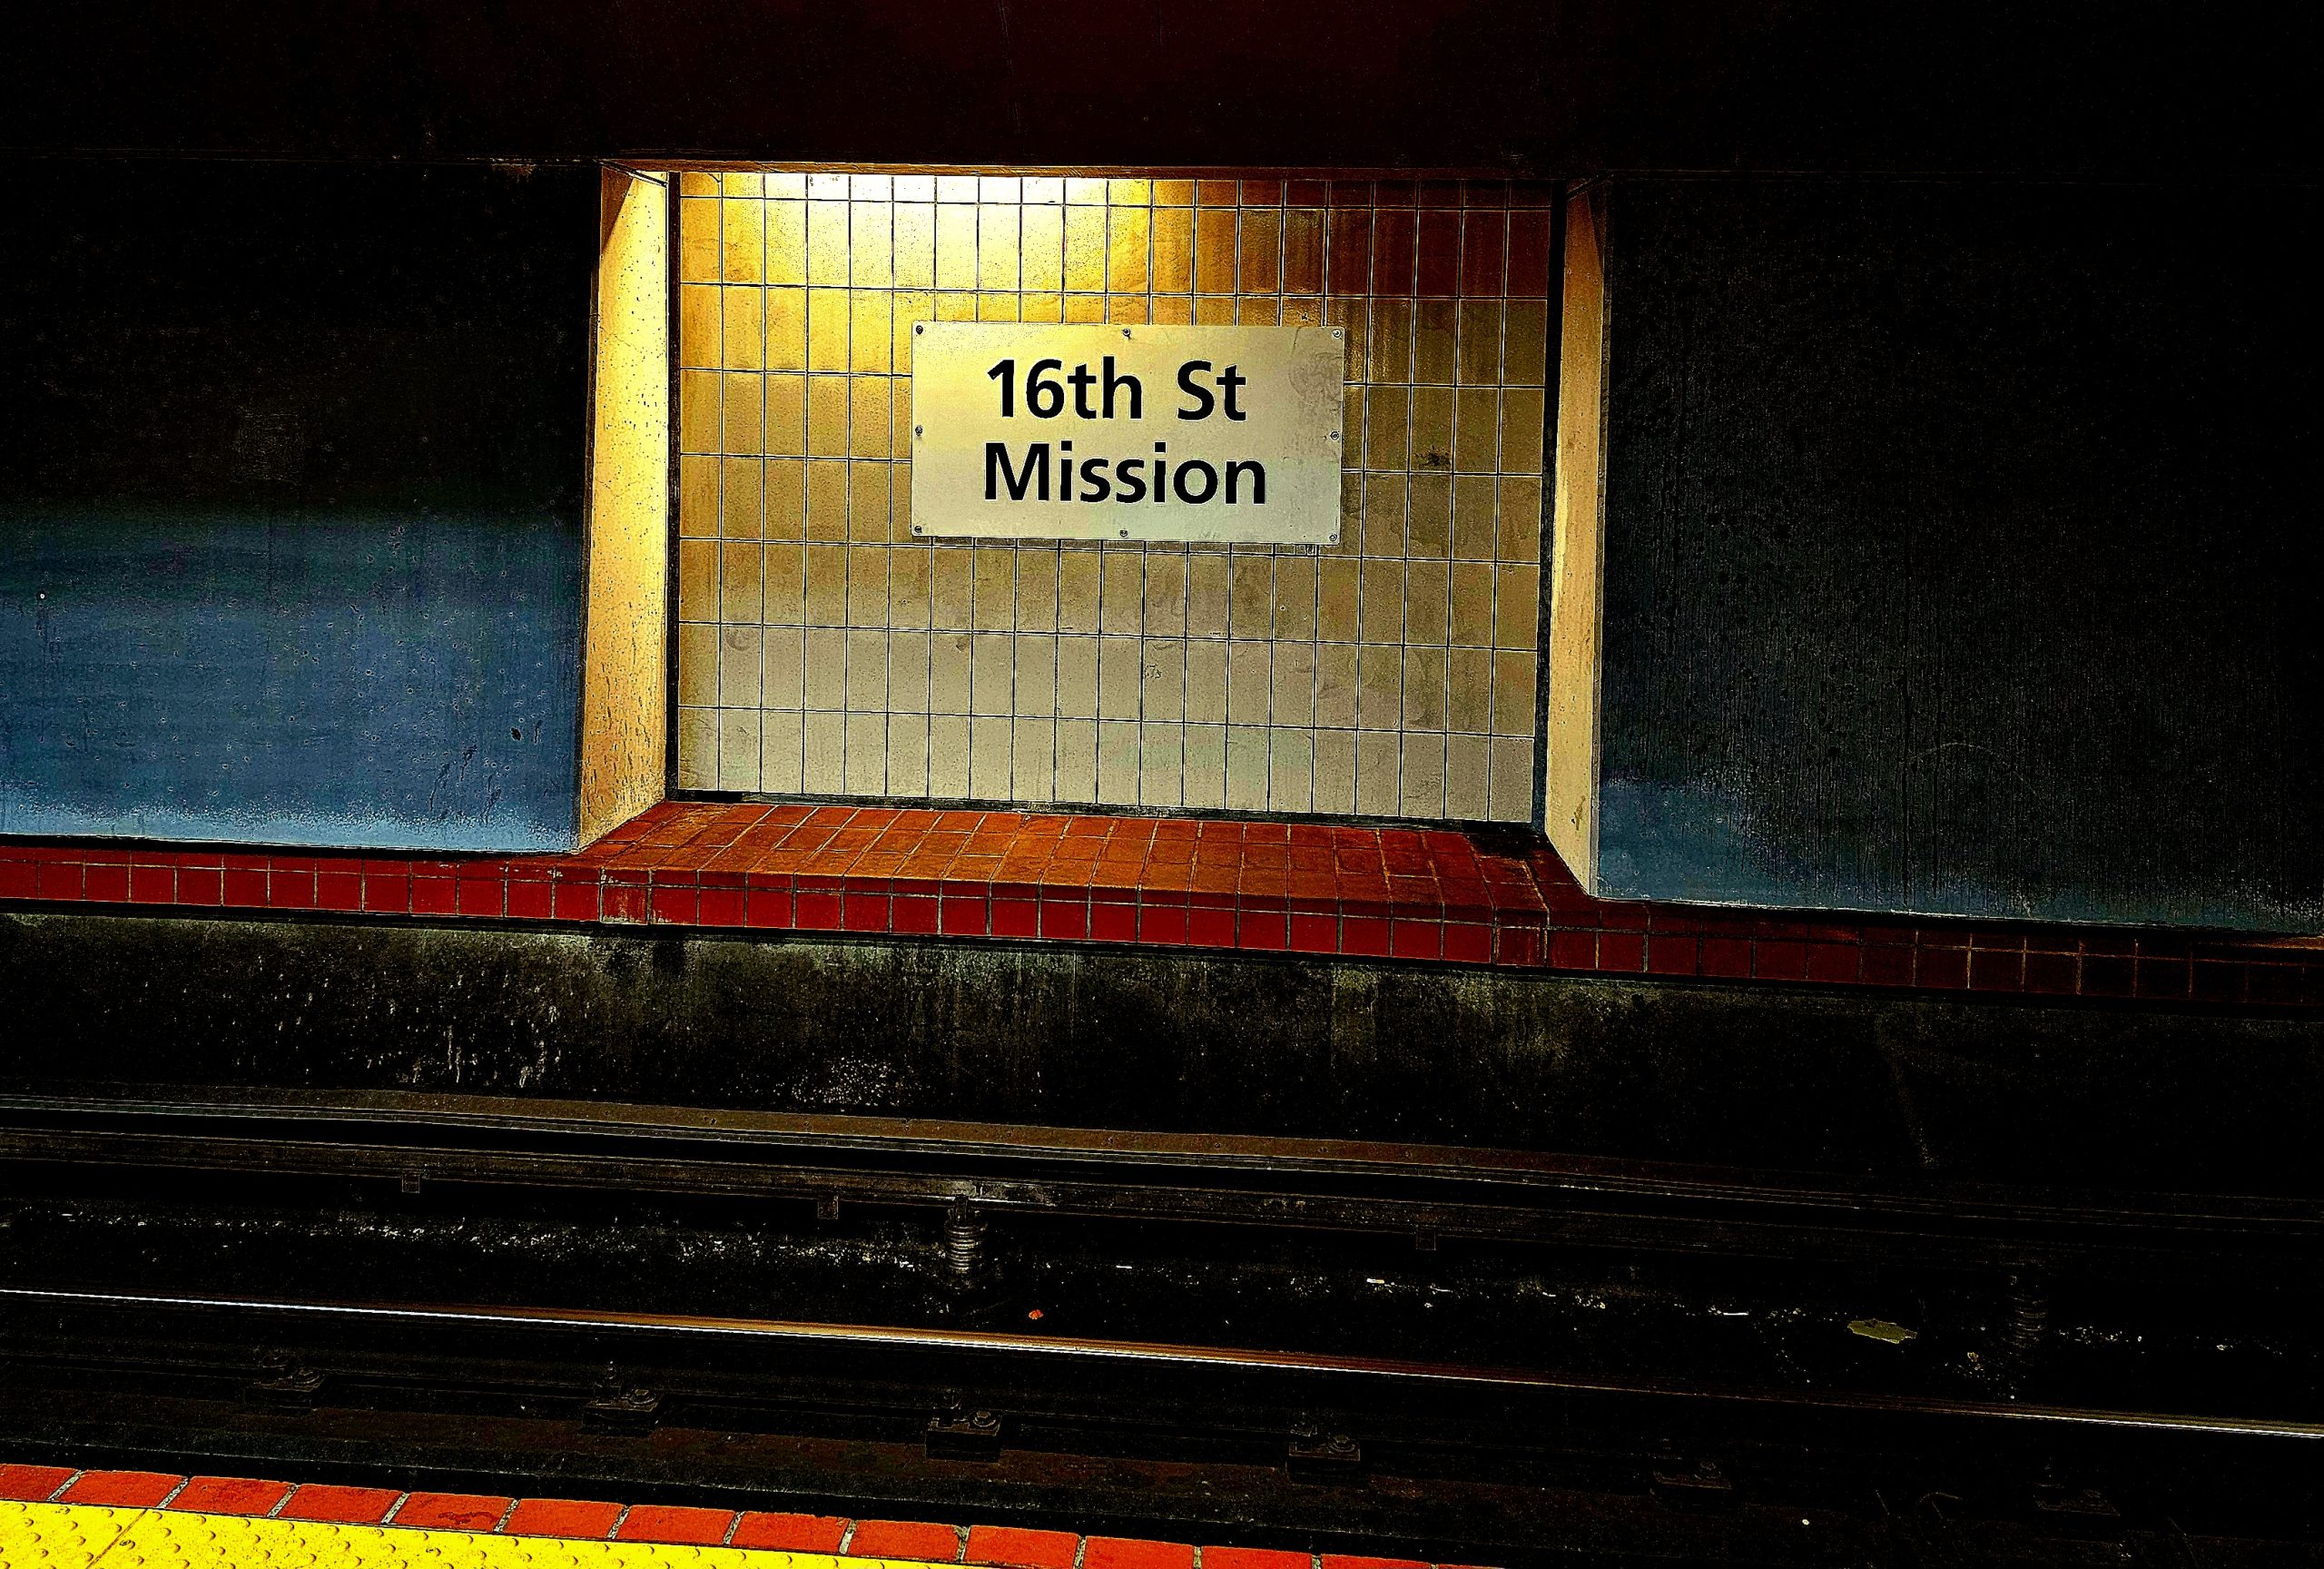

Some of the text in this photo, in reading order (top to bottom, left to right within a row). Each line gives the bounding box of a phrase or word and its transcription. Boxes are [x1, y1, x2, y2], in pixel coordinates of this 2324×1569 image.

[987, 356, 1246, 421] 16th St
[985, 440, 1265, 505] Mission
